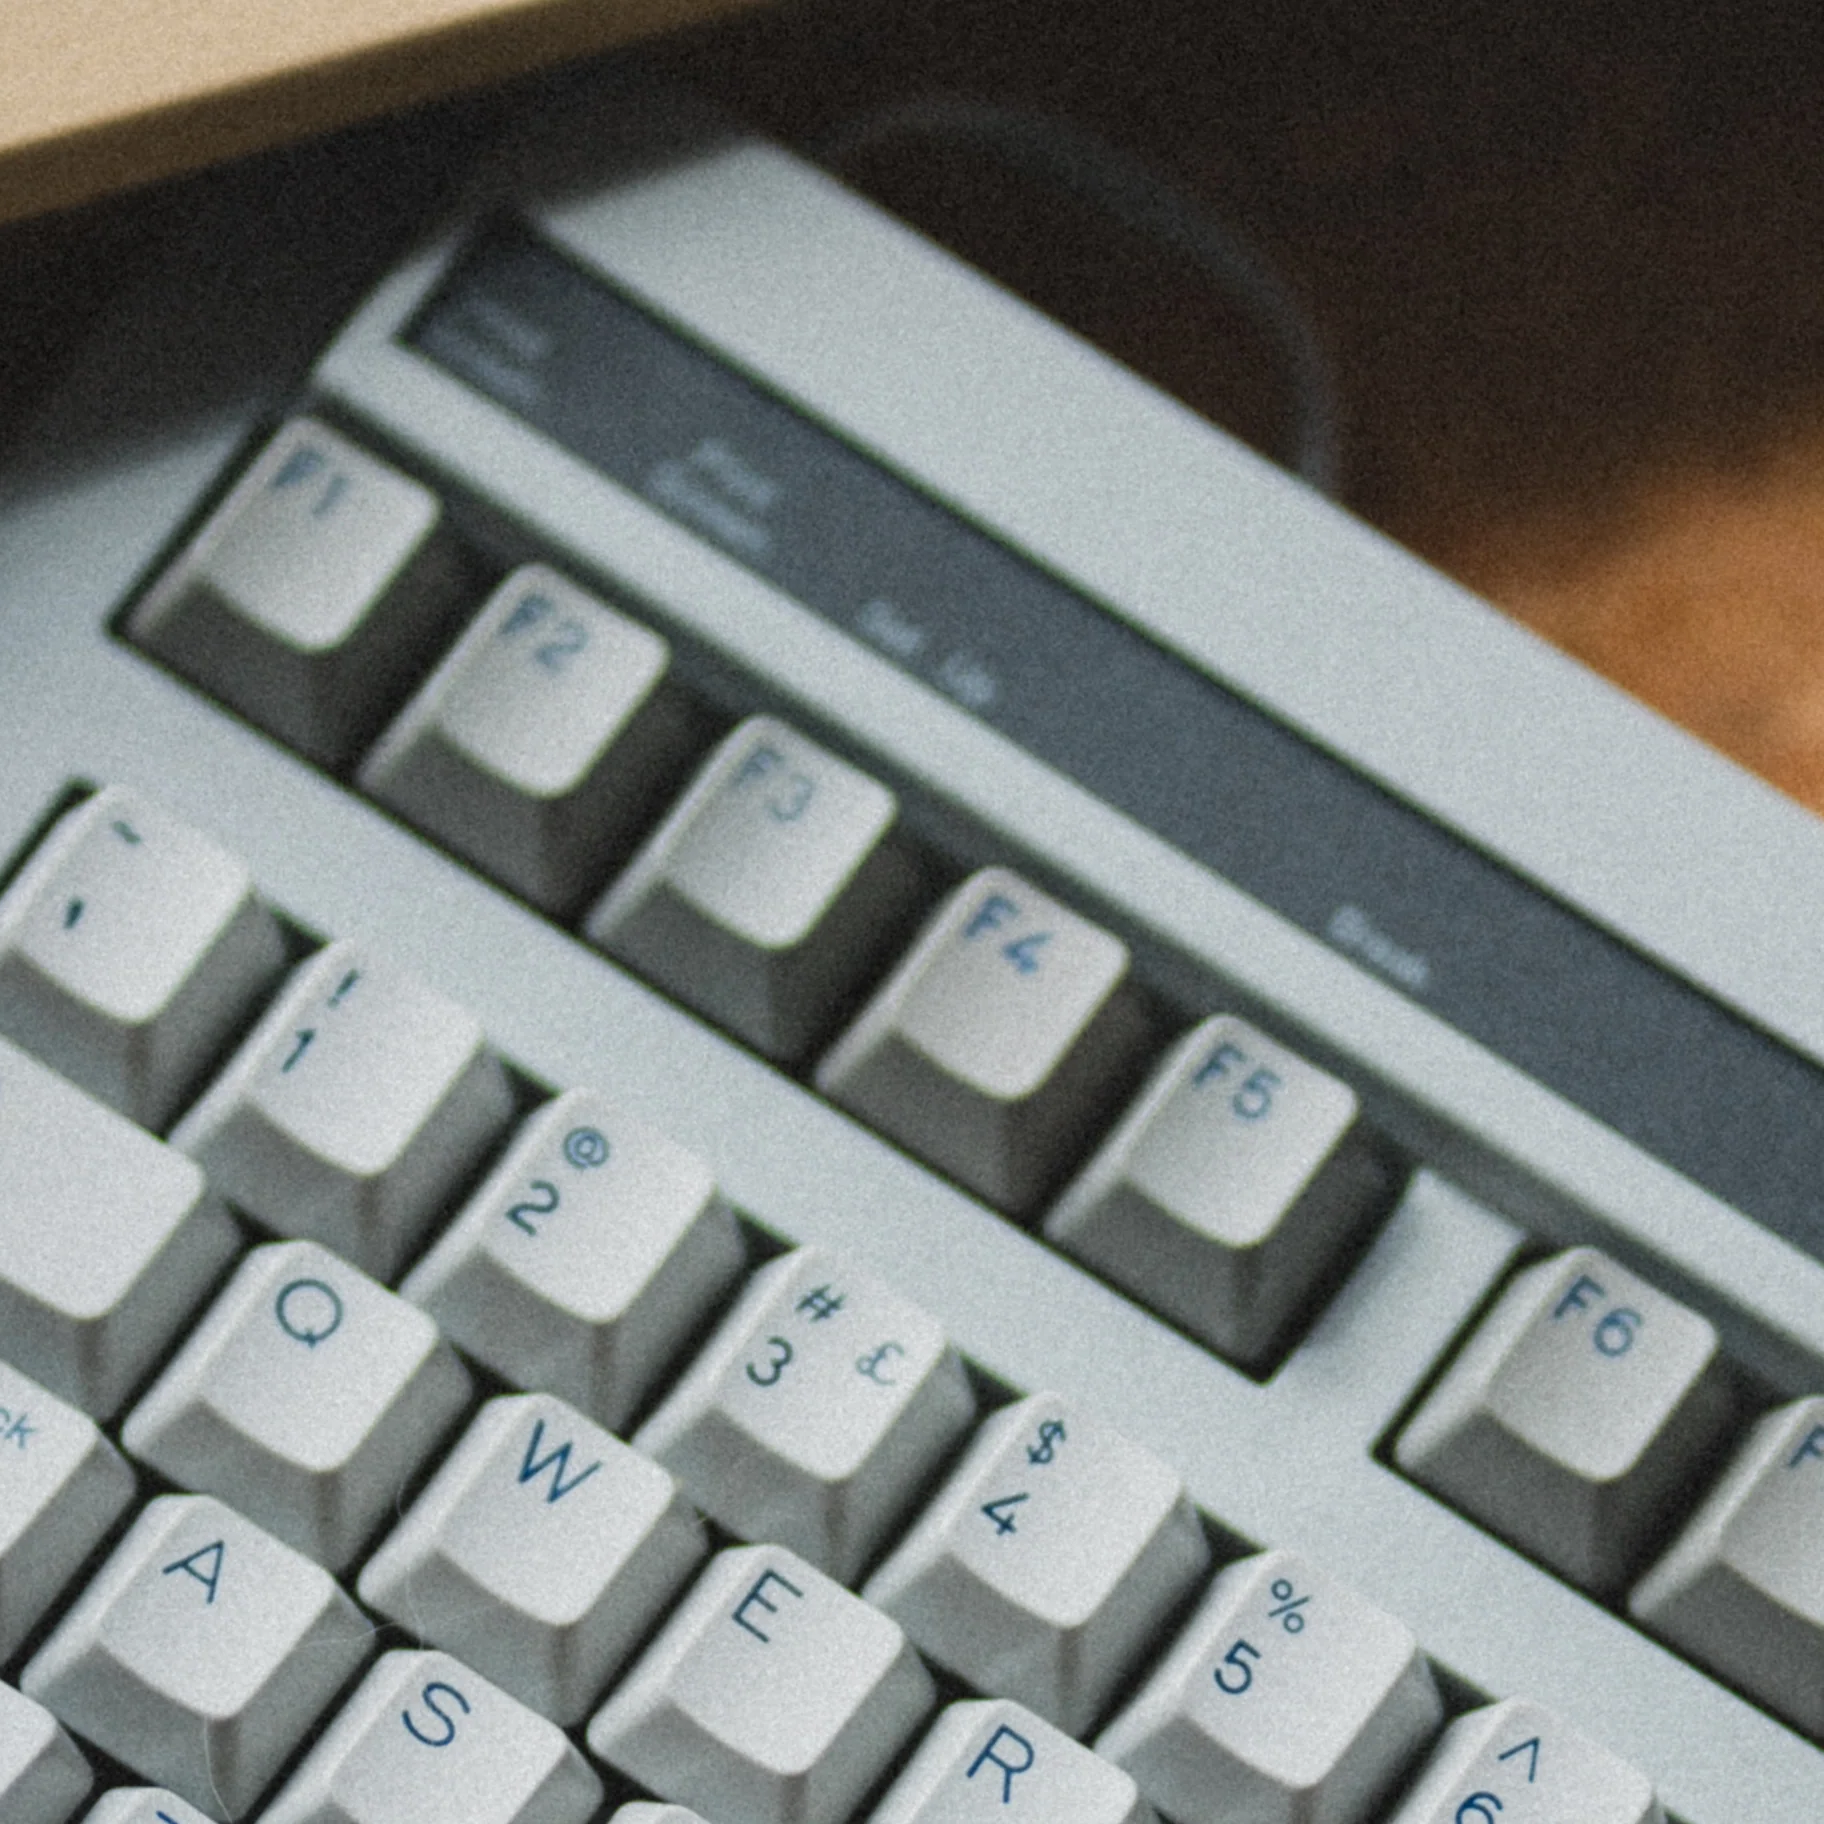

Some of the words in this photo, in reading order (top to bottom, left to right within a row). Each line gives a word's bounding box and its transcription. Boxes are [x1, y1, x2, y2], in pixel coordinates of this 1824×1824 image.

[963, 893, 1057, 974] F4
[282, 1029, 315, 1073] 1
[1191, 1041, 1277, 1118] F5
[561, 1126, 610, 1171] @
[504, 1180, 560, 1236] 2
[274, 1278, 343, 1348] Q
[796, 1285, 844, 1322] #
[1551, 1274, 1641, 1356] F6
[745, 1336, 794, 1387] 3
[855, 1342, 904, 1385] £
[518, 1419, 600, 1503] W
[1027, 1420, 1066, 1465] $
[981, 1493, 1028, 1535] 4
[162, 1540, 225, 1604] A
[731, 1568, 803, 1643] E
[1268, 1578, 1310, 1634] %
[1213, 1639, 1260, 1695] 5
[401, 1681, 470, 1747] S
[966, 1724, 1034, 1804] R
